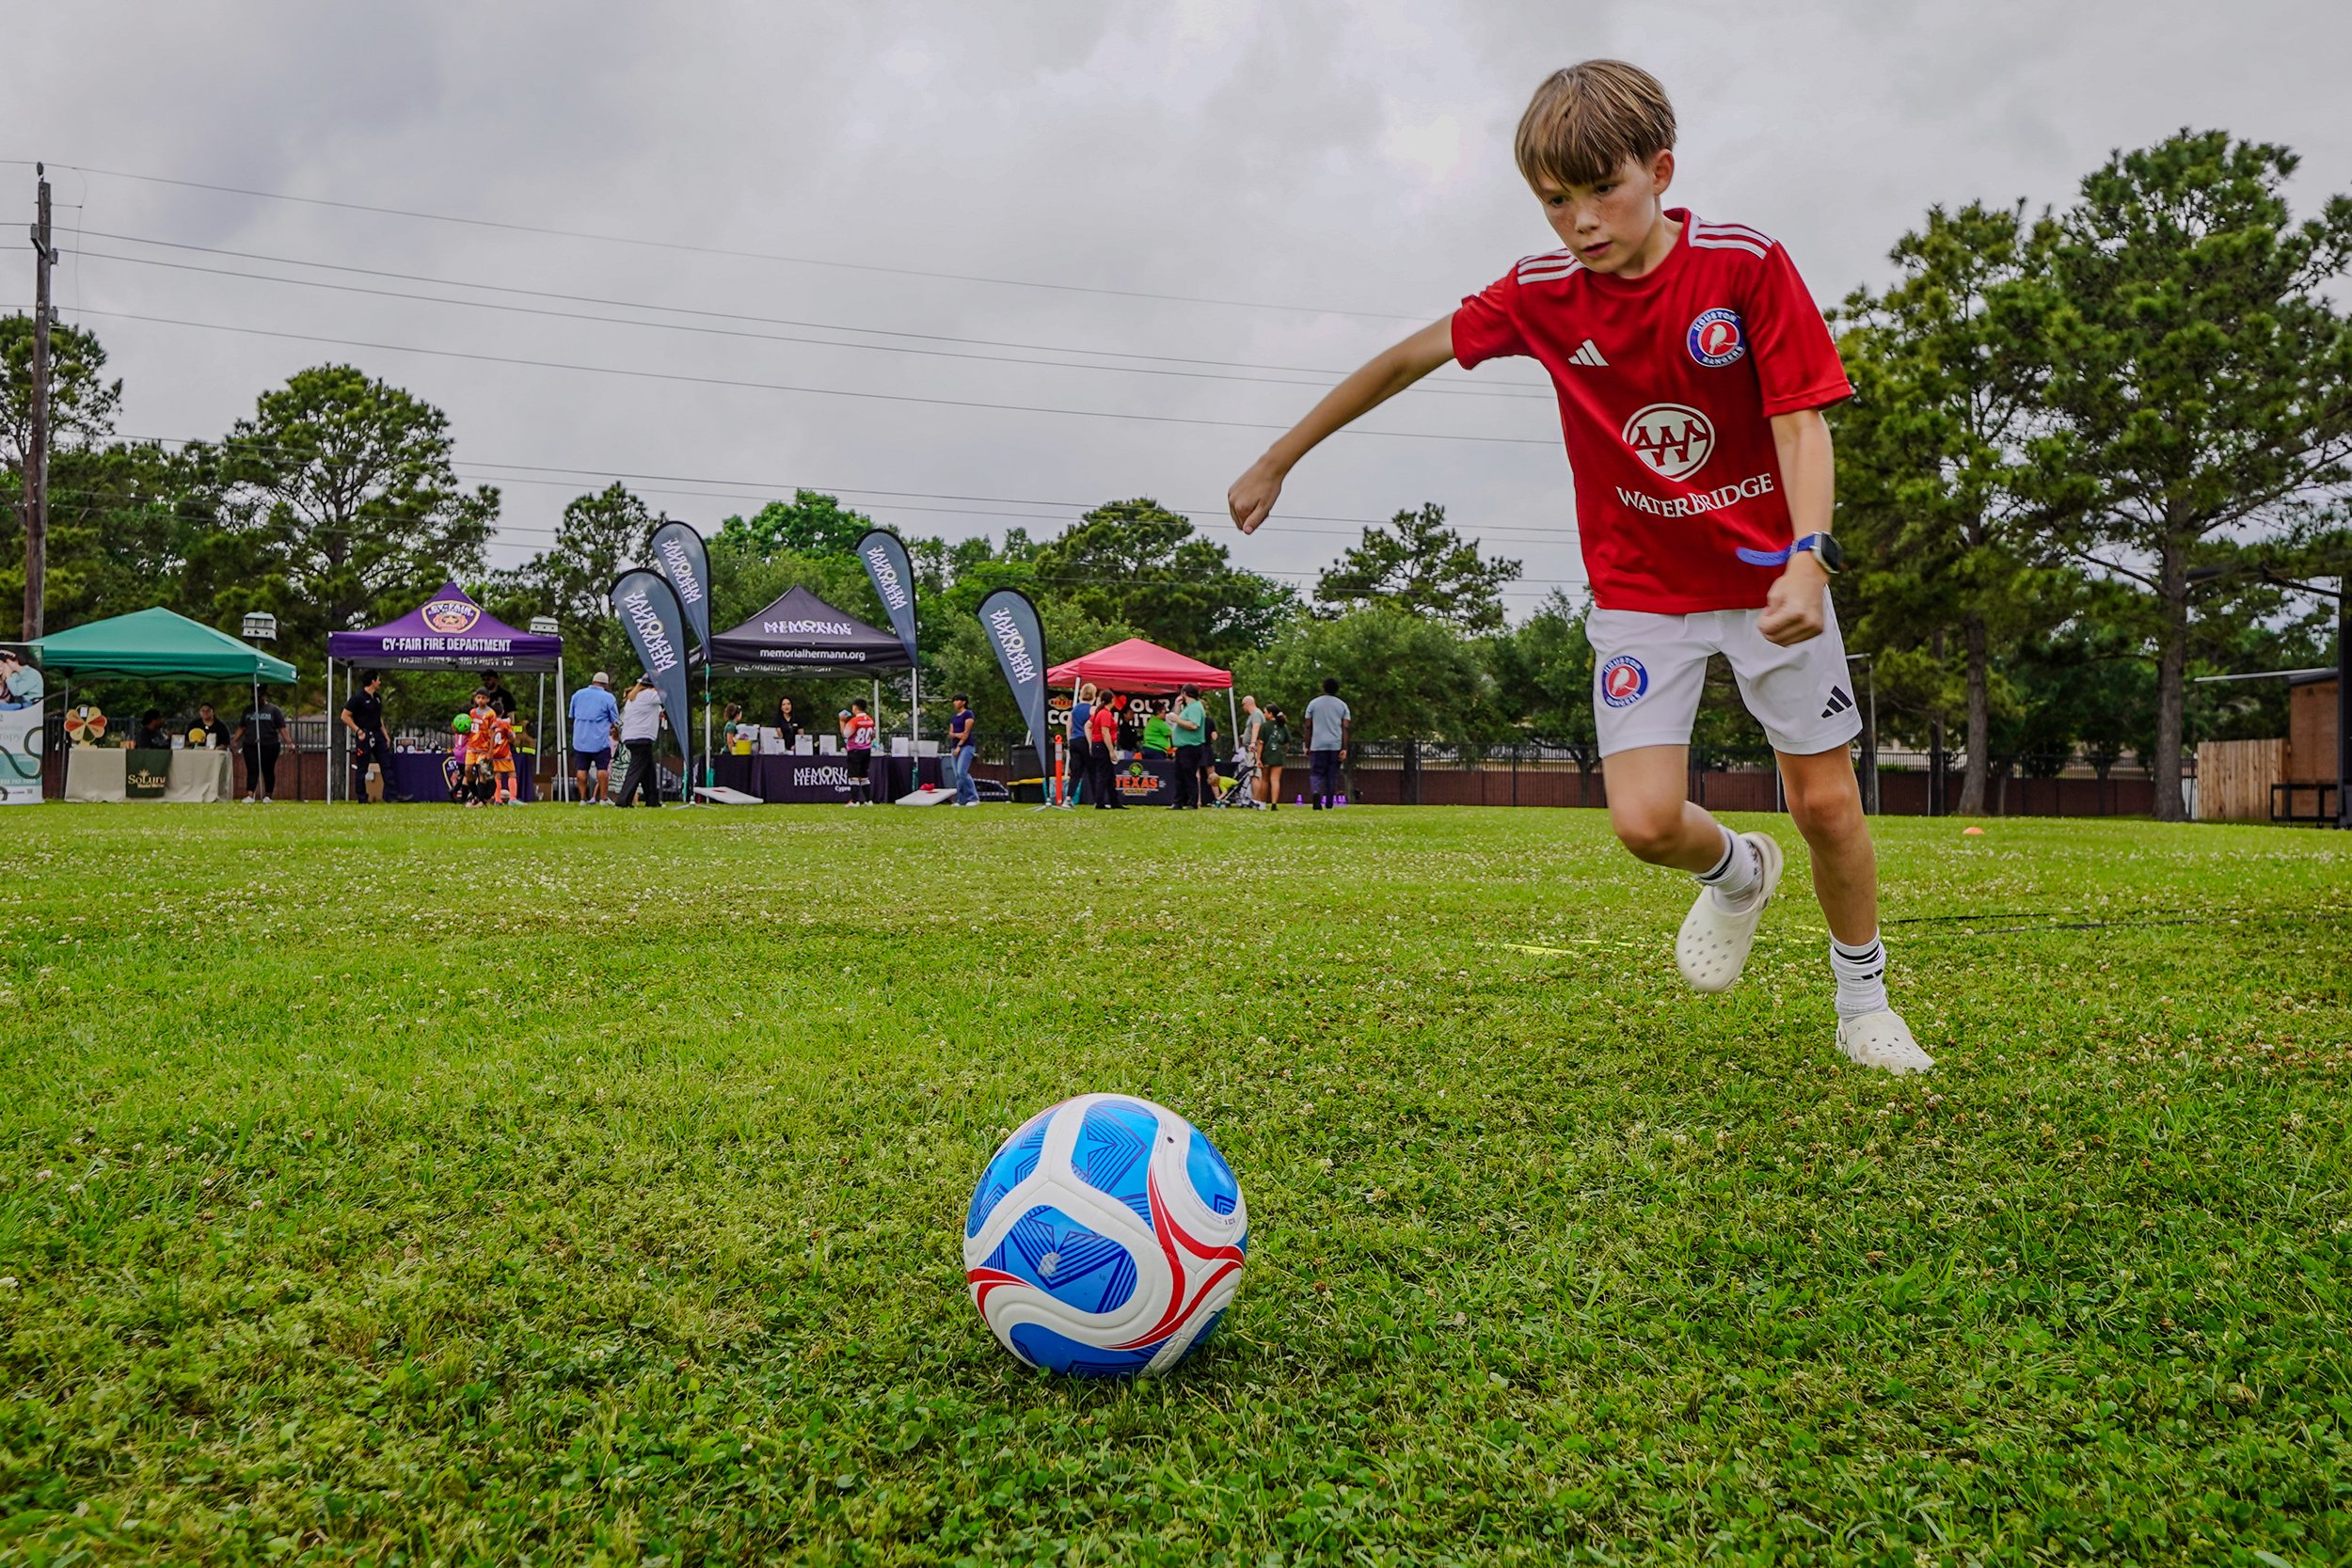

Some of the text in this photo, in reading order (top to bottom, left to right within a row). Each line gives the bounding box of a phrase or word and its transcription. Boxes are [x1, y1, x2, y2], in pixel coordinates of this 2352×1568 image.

[382, 638, 512, 652] CY-FAIR FIRE DEPARTMENT
[759, 649, 866, 661] memorialhermann.org
[793, 766, 848, 779] MEMORI
[793, 774, 848, 786] HERMAN
[1115, 776, 1158, 788] TEXAS
